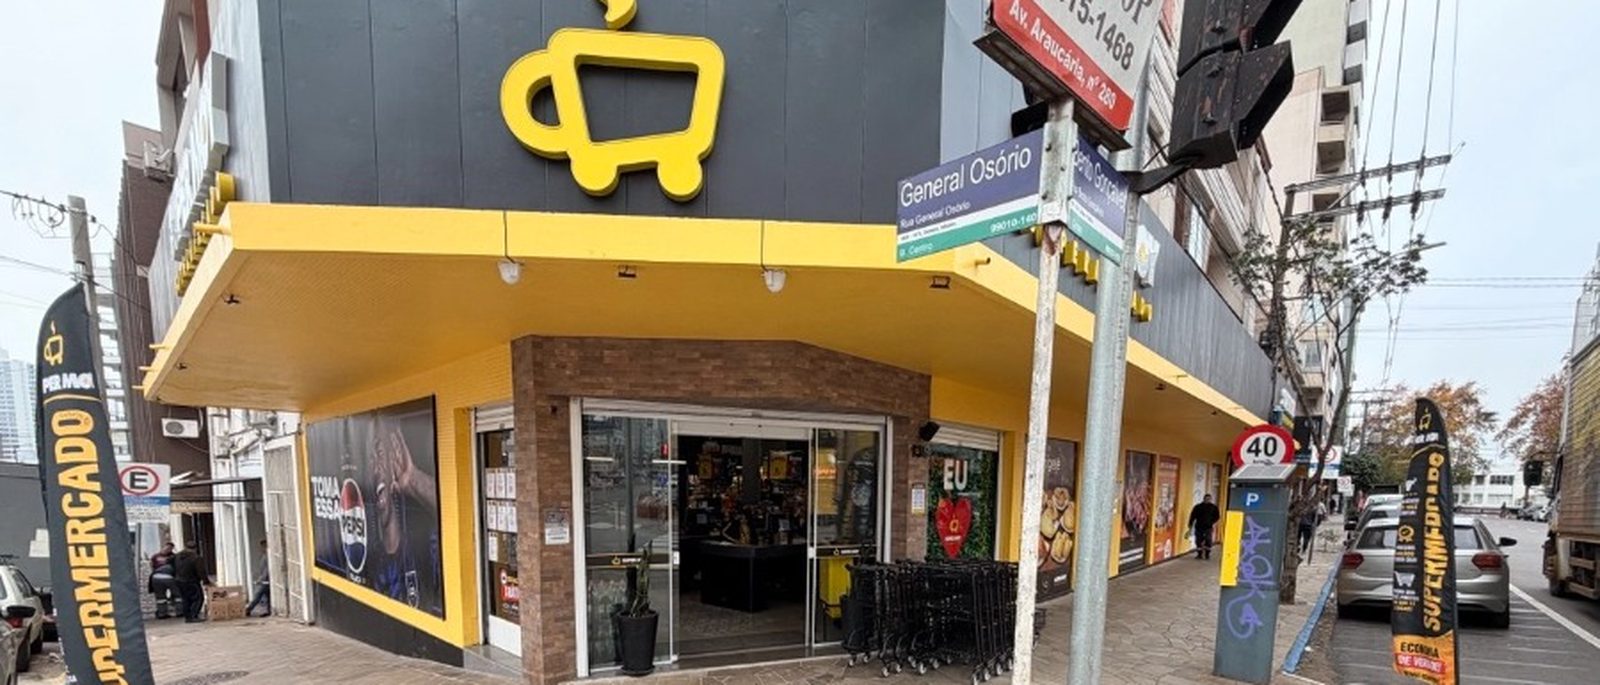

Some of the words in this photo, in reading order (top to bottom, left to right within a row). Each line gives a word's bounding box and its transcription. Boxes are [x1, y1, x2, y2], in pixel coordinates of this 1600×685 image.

[1009, 0, 1028, 29] Av.
[1031, 17, 1085, 87] Araucária,
[1098, 82, 1118, 110] 280
[900, 163, 965, 208] General
[969, 144, 1032, 185] Osório
[915, 207, 944, 225] General
[945, 200, 972, 217] Osório
[1246, 436, 1278, 458] 40
[129, 471, 149, 490] E
[943, 459, 968, 491] EU
[311, 476, 341, 499] TOMA
[1246, 492, 1260, 506] P
[314, 496, 342, 520] ESSA
[342, 515, 366, 538] PEPSI
